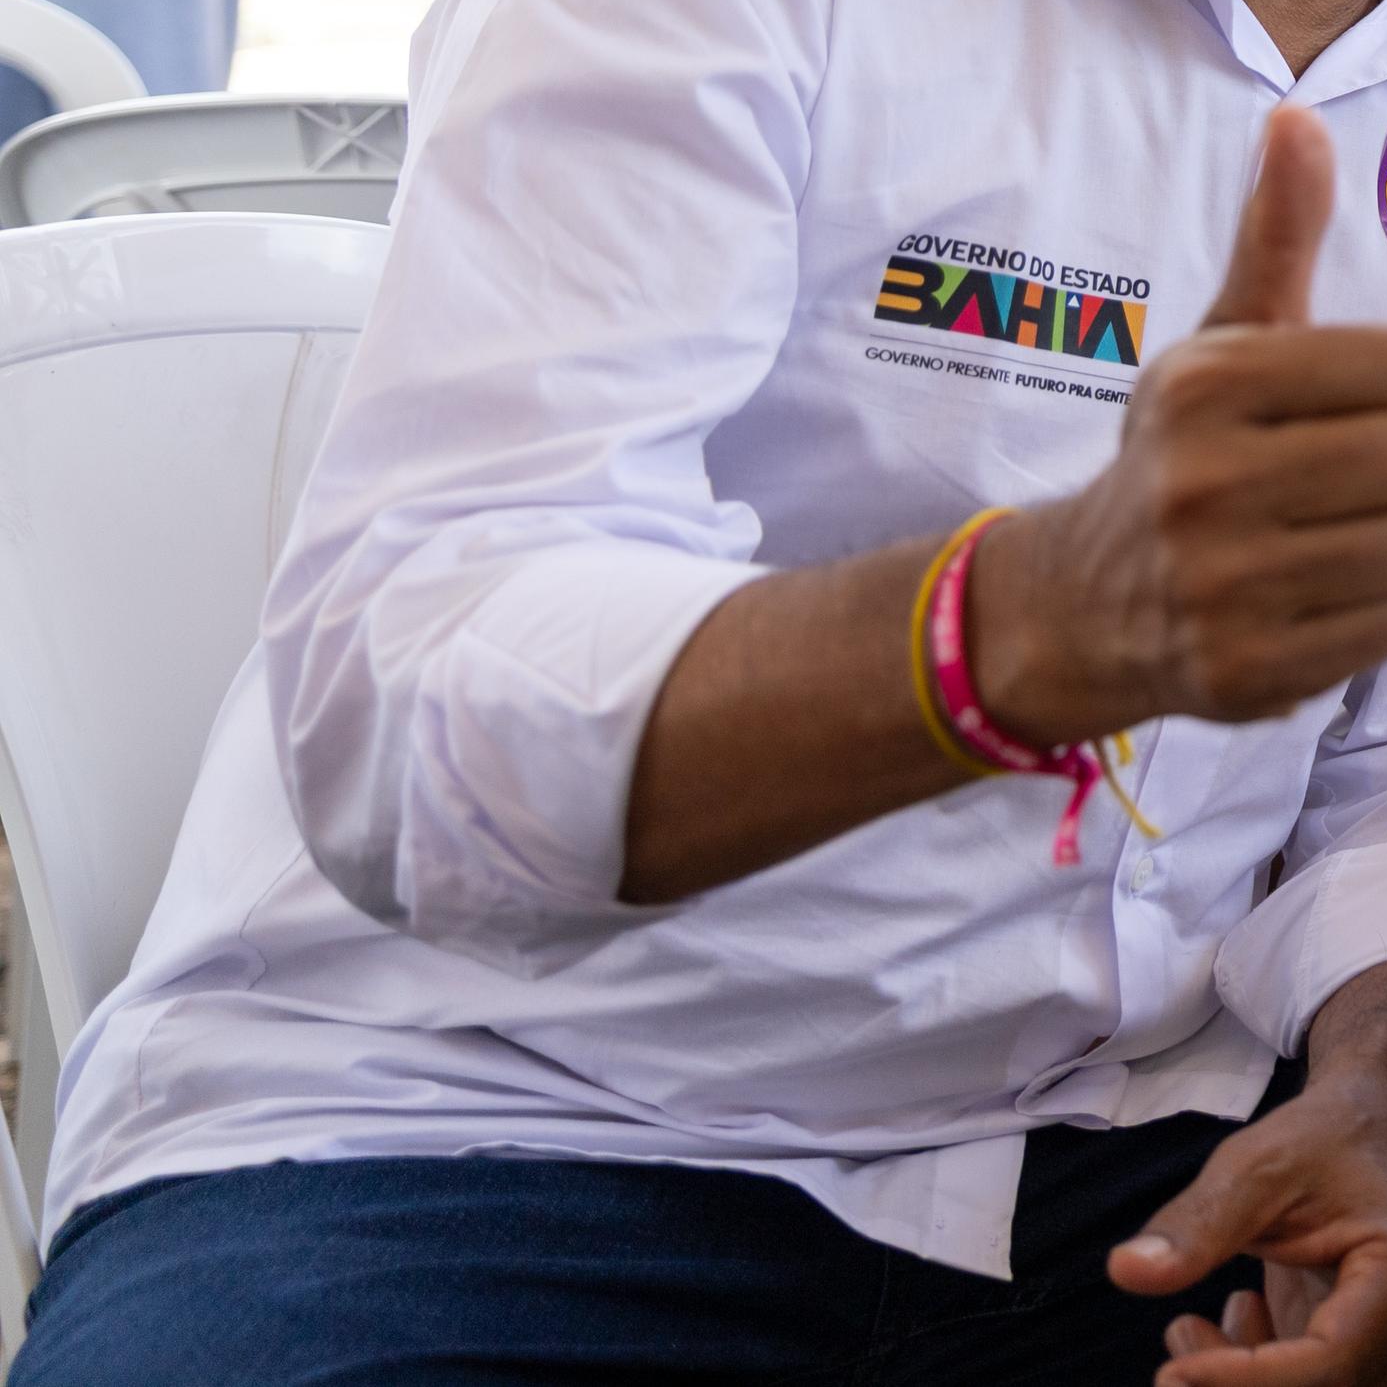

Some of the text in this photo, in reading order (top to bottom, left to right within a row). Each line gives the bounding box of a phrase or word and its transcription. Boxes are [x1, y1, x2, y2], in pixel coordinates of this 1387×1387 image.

[897, 233, 1151, 300] GOVERNO DO ESTADO
[873, 254, 1144, 368] BAHIA
[865, 345, 1132, 407] GOVERNO PRESENTE FUTURO PRA GENTE
